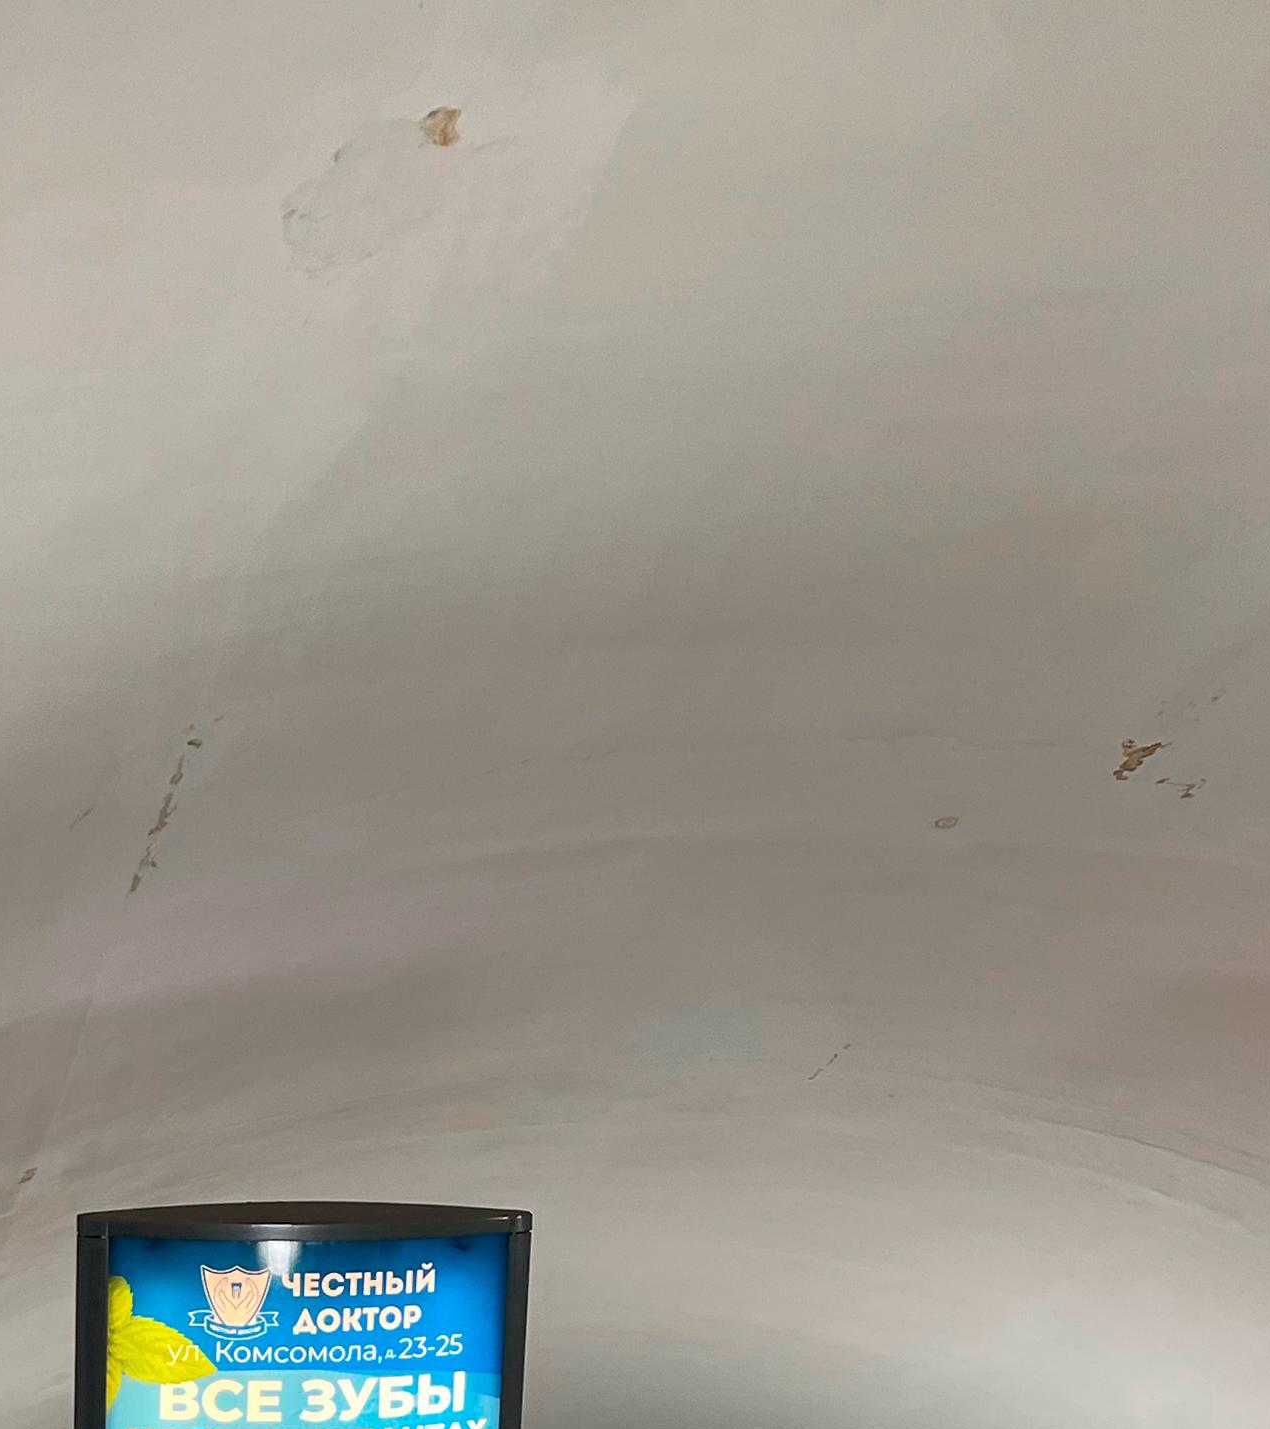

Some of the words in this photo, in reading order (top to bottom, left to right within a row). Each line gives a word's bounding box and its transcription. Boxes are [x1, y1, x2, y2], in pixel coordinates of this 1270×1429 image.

[281, 1262, 437, 1297] ЧЕСТНЫЙ
[293, 1305, 422, 1335] ДОКТОР
[167, 1344, 206, 1366] ул.
[215, 1341, 383, 1364] Комсомола,
[398, 1333, 463, 1359] 23-25
[158, 1380, 283, 1423] ВСЕ
[299, 1371, 466, 1423] ЗУБЫ
